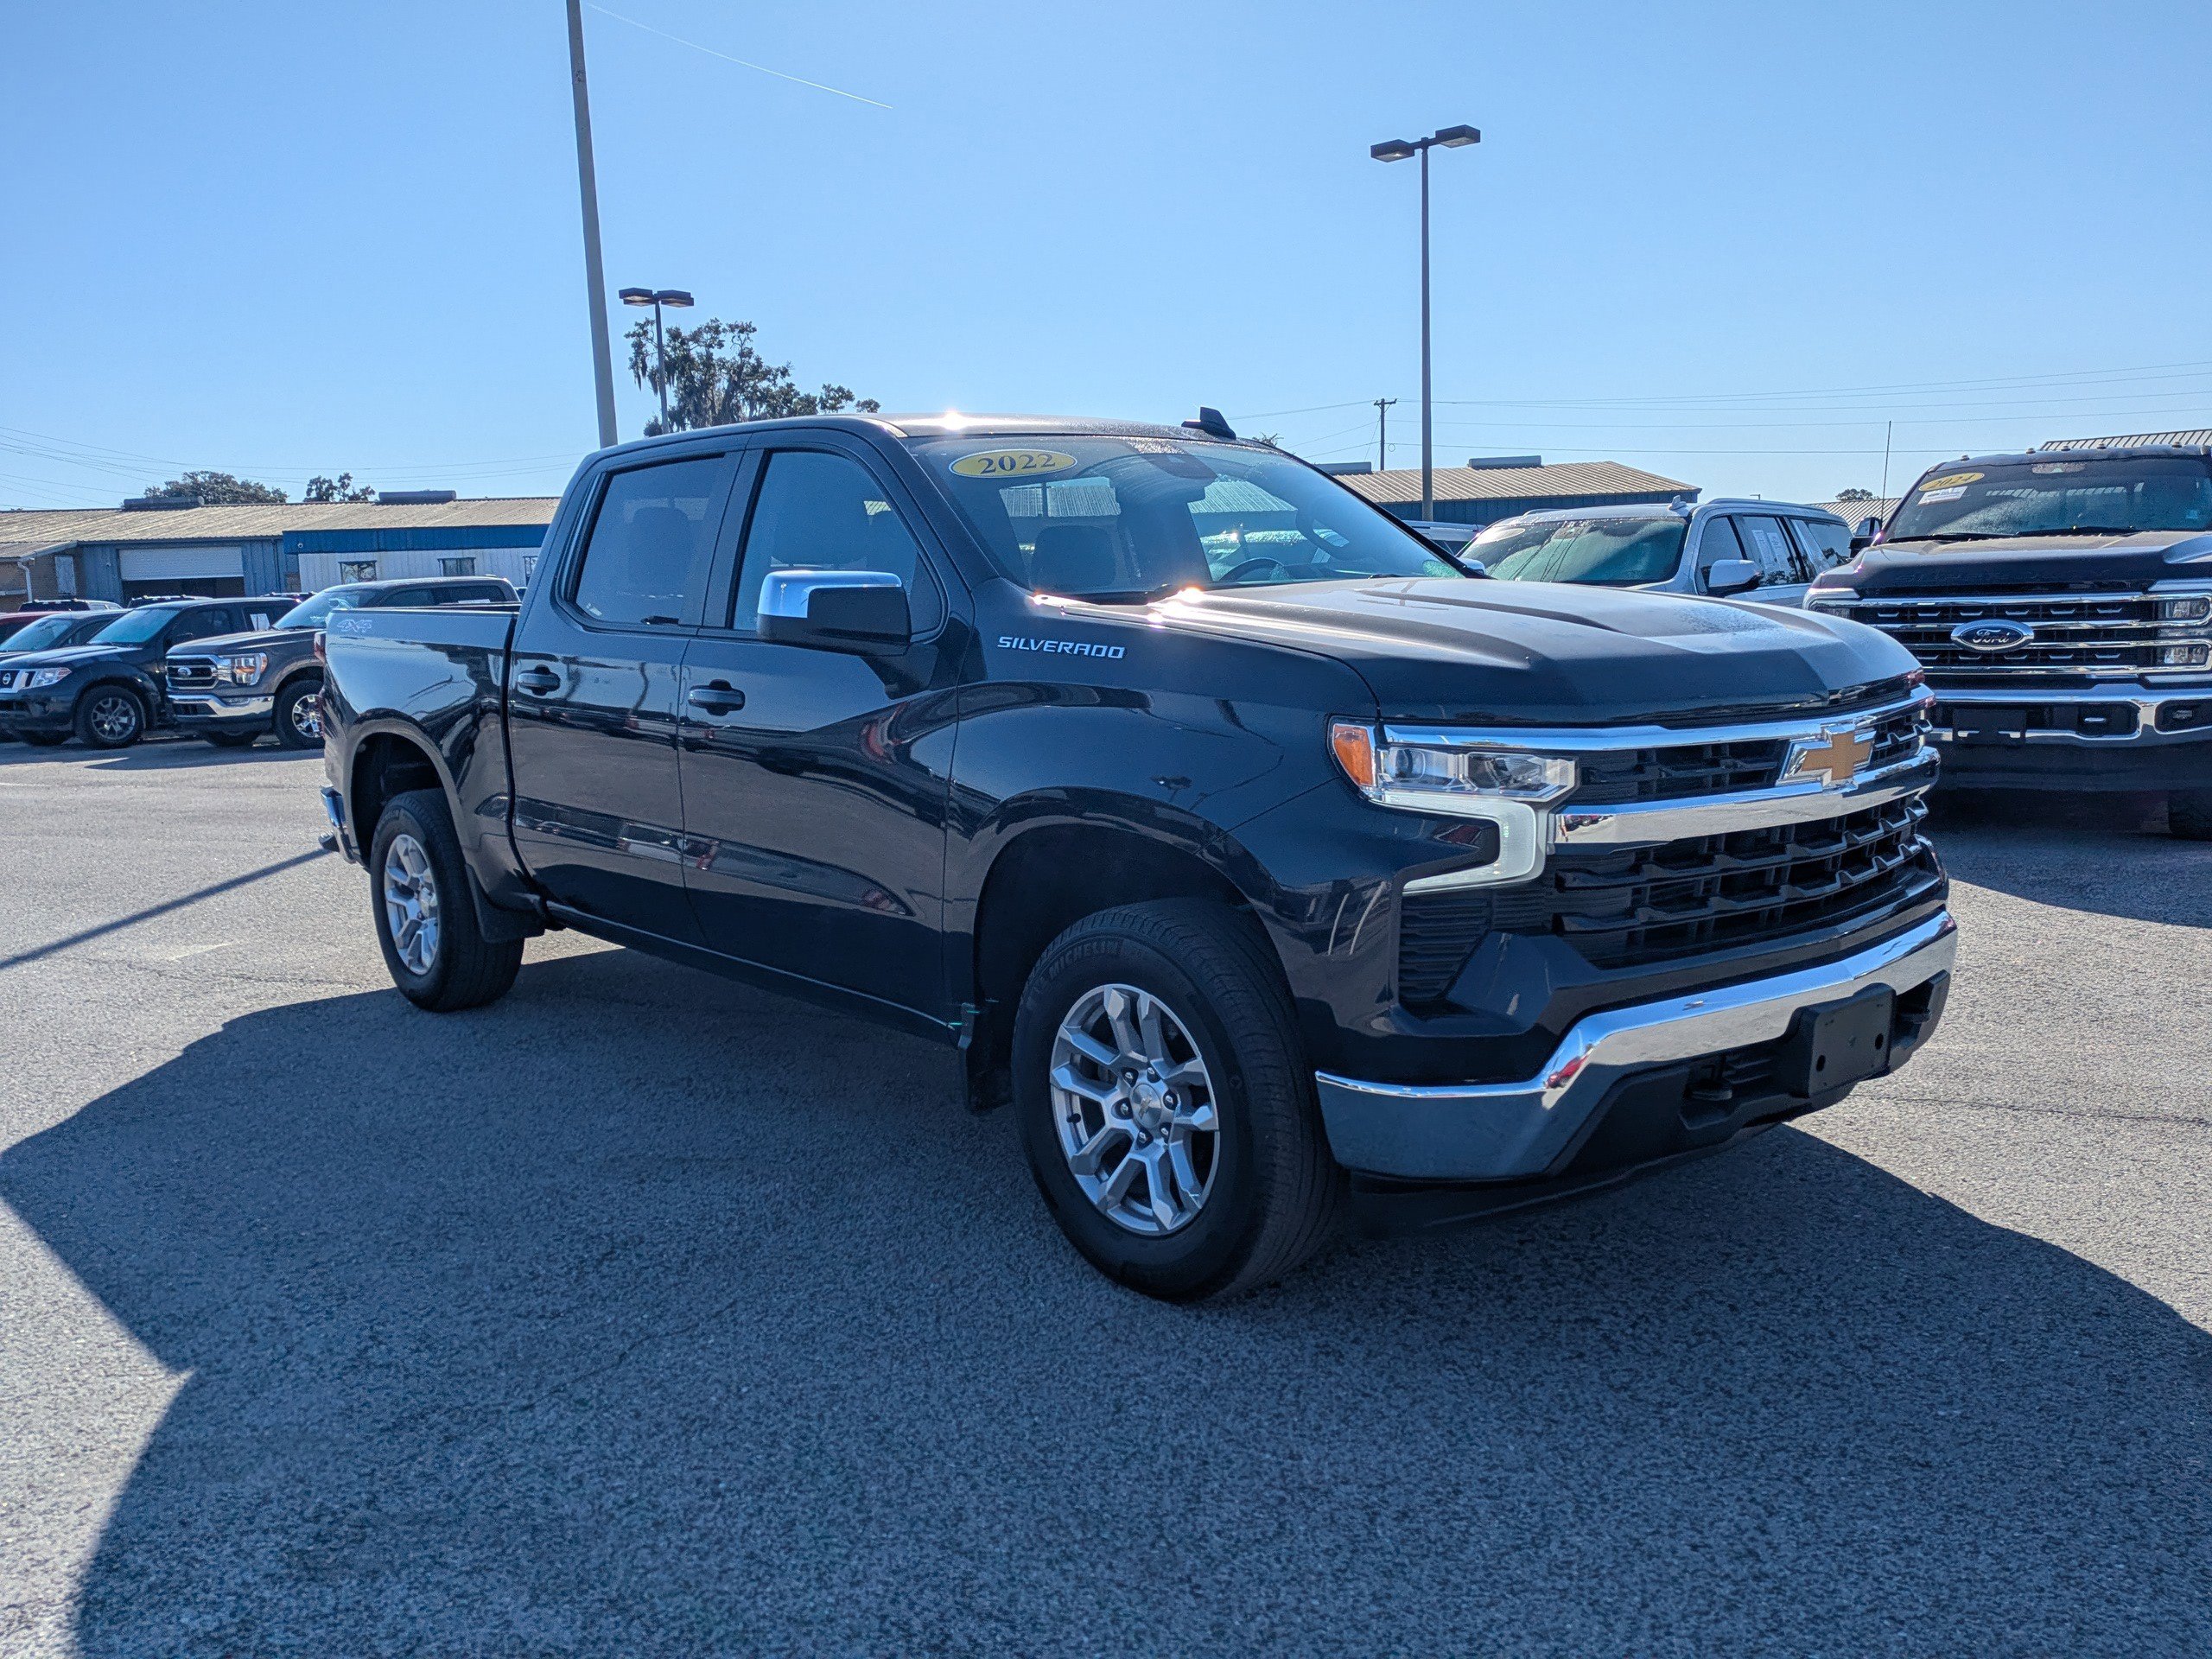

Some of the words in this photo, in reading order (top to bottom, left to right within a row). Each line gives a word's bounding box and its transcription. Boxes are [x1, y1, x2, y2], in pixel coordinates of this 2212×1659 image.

[978, 454, 1056, 474] 2022
[1973, 628, 2010, 643] Ford
[997, 636, 1125, 659] SILVERADO
